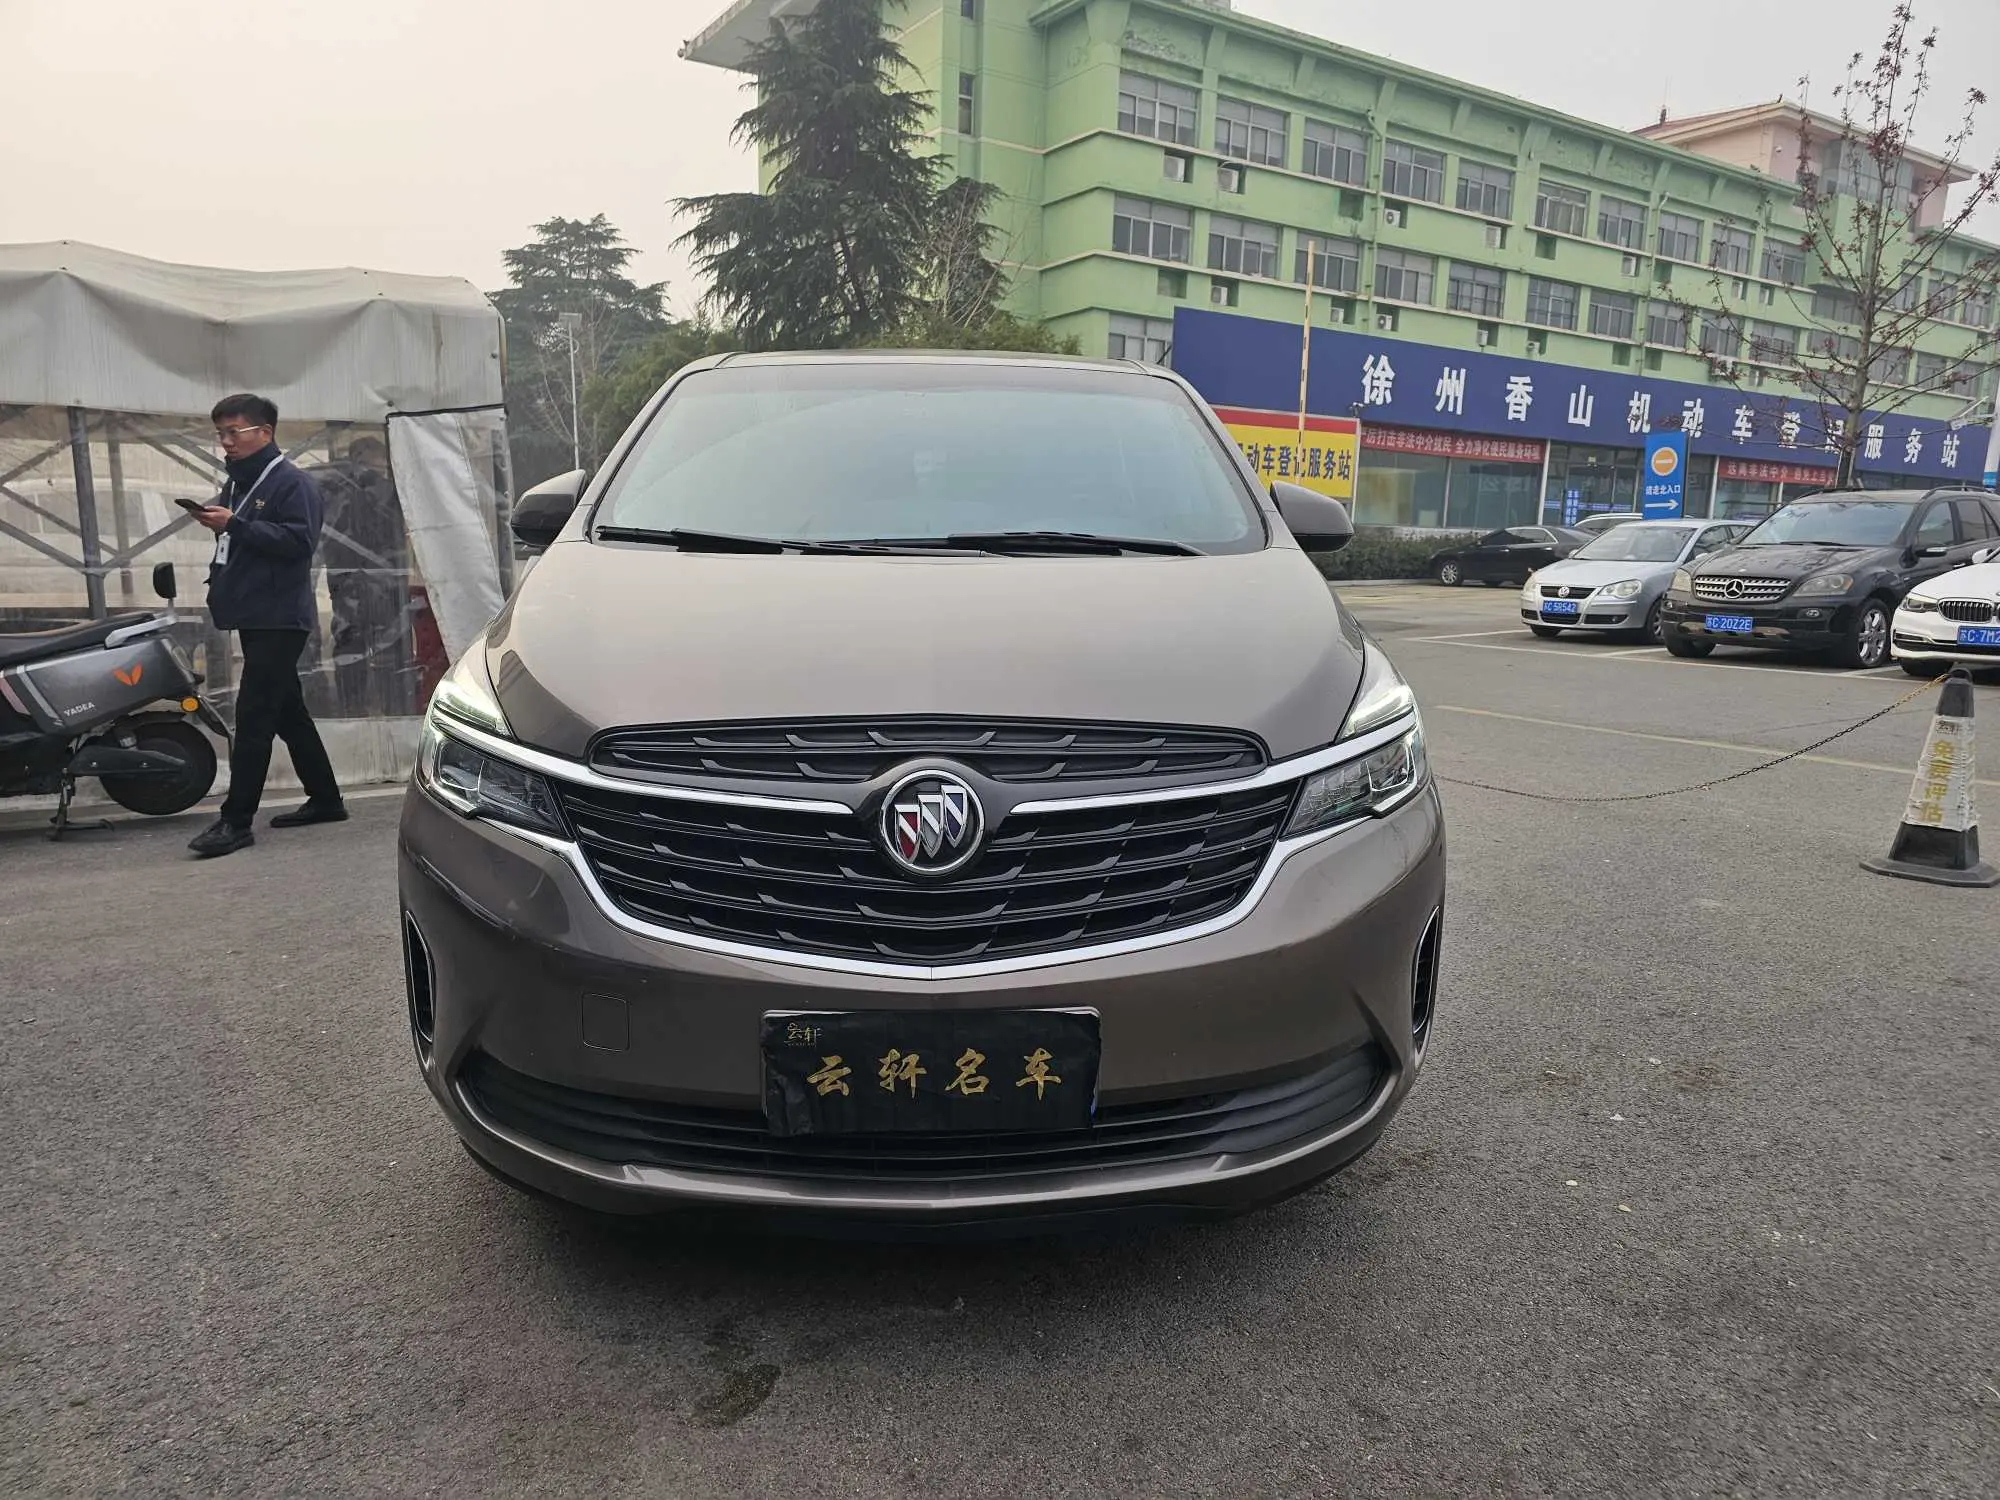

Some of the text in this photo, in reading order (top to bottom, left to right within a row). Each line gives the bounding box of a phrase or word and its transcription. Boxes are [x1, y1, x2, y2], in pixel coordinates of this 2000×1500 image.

[1362, 354, 1960, 468] 徐州香山机动车登记服务站
[1237, 442, 1351, 480] 动车登记服务站
[63, 702, 96, 717] YADEA
[806, 1047, 1063, 1101] 云轩名车
